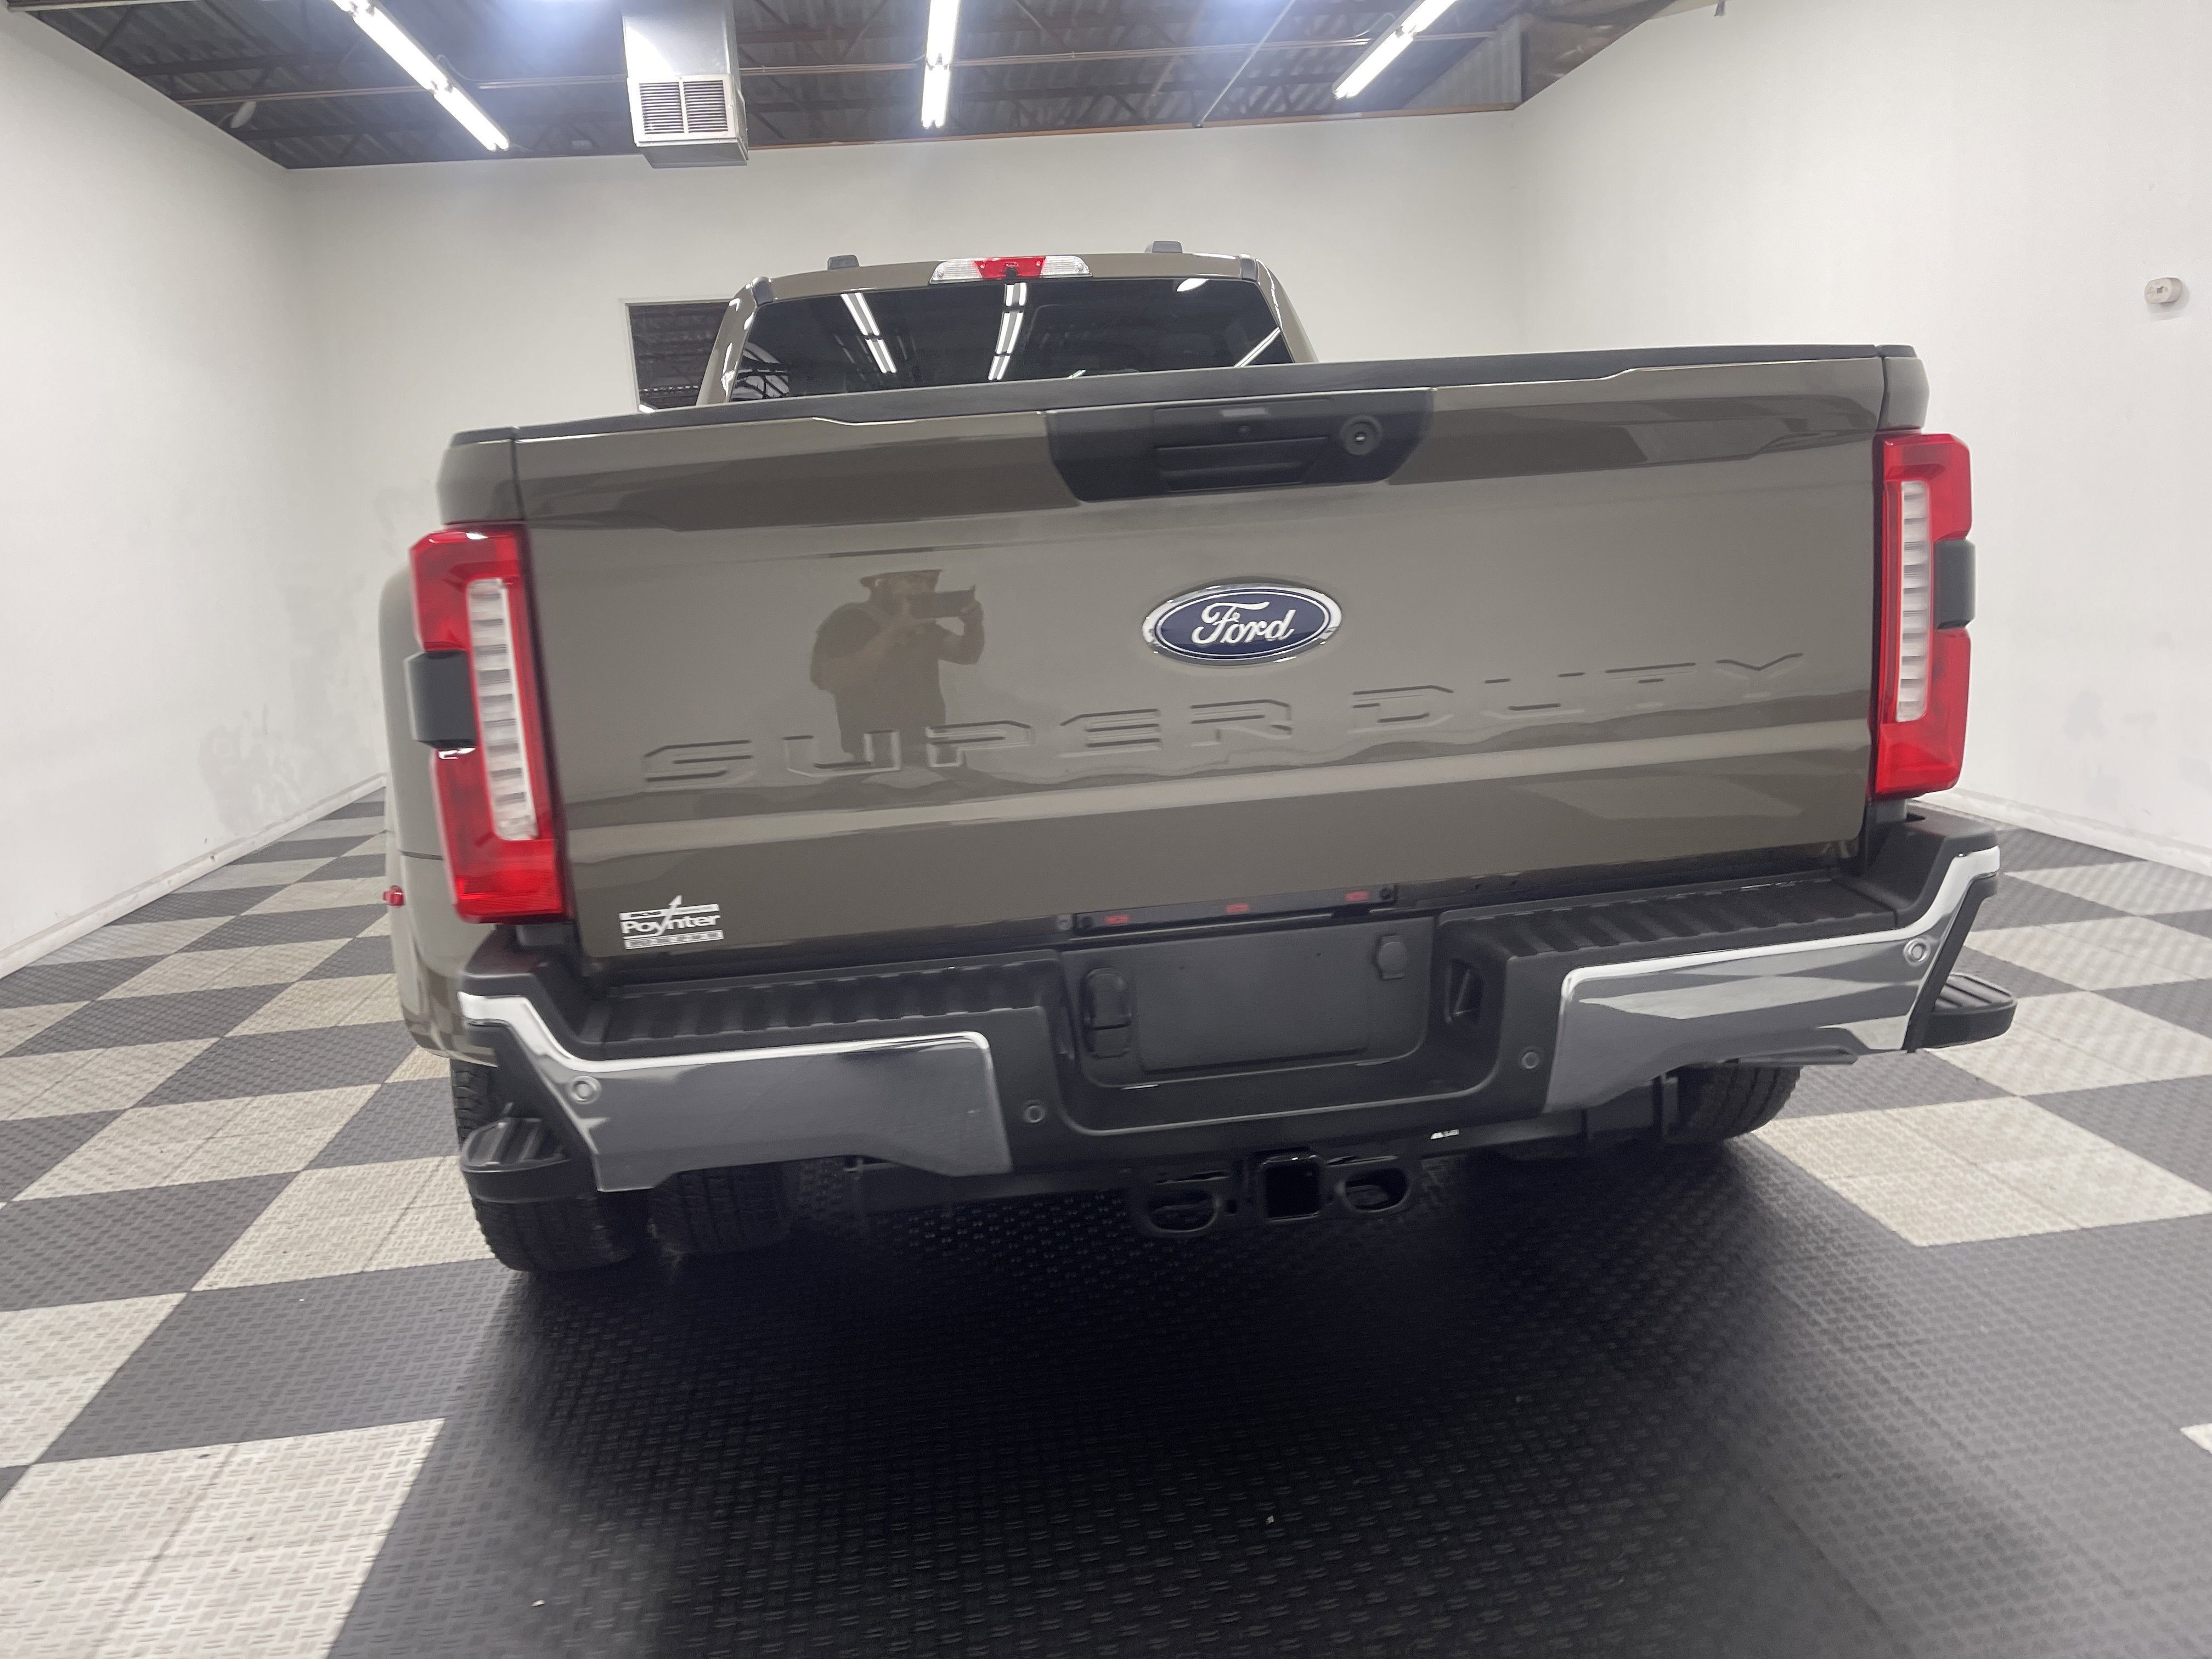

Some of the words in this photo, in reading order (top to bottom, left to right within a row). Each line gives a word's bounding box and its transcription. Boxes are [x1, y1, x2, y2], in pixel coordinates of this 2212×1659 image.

[1191, 601, 1296, 644] Ford
[643, 699, 1293, 791] SUPER
[1348, 653, 1803, 733] DUTY
[620, 914, 721, 936] Poynter
